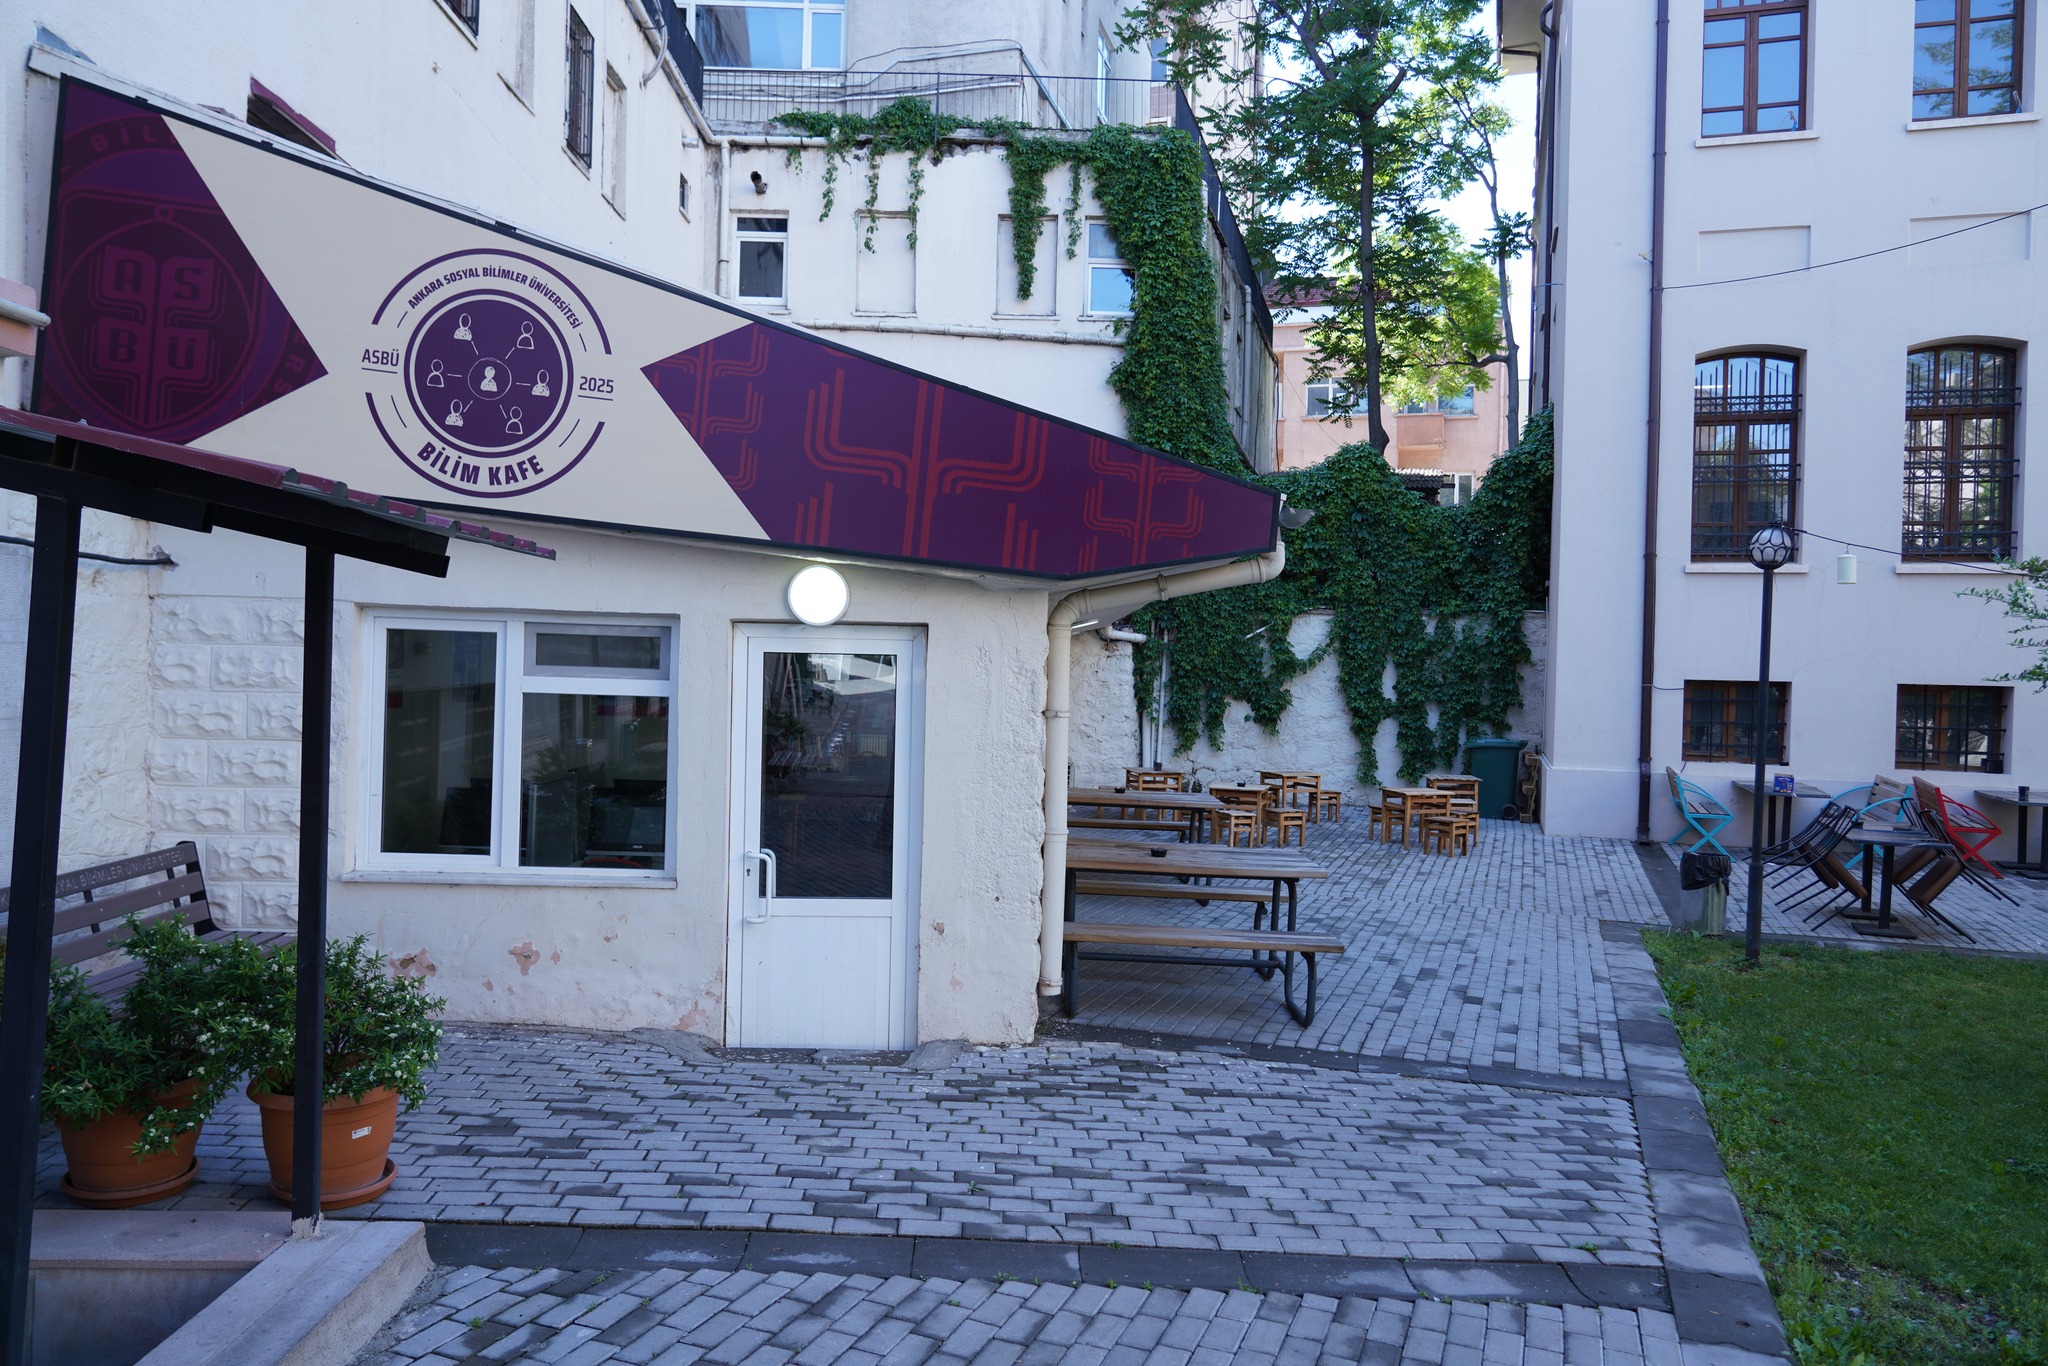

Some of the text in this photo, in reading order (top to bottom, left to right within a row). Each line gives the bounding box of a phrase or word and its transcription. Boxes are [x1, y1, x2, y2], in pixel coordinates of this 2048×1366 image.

[408, 265, 583, 329] ANKARA SOSYAL BİLİMLER ÜNİVERSİTESİ
[361, 348, 399, 367] ASBÜ
[579, 376, 614, 394] 2025
[417, 441, 544, 486] BİLİM KAFE
